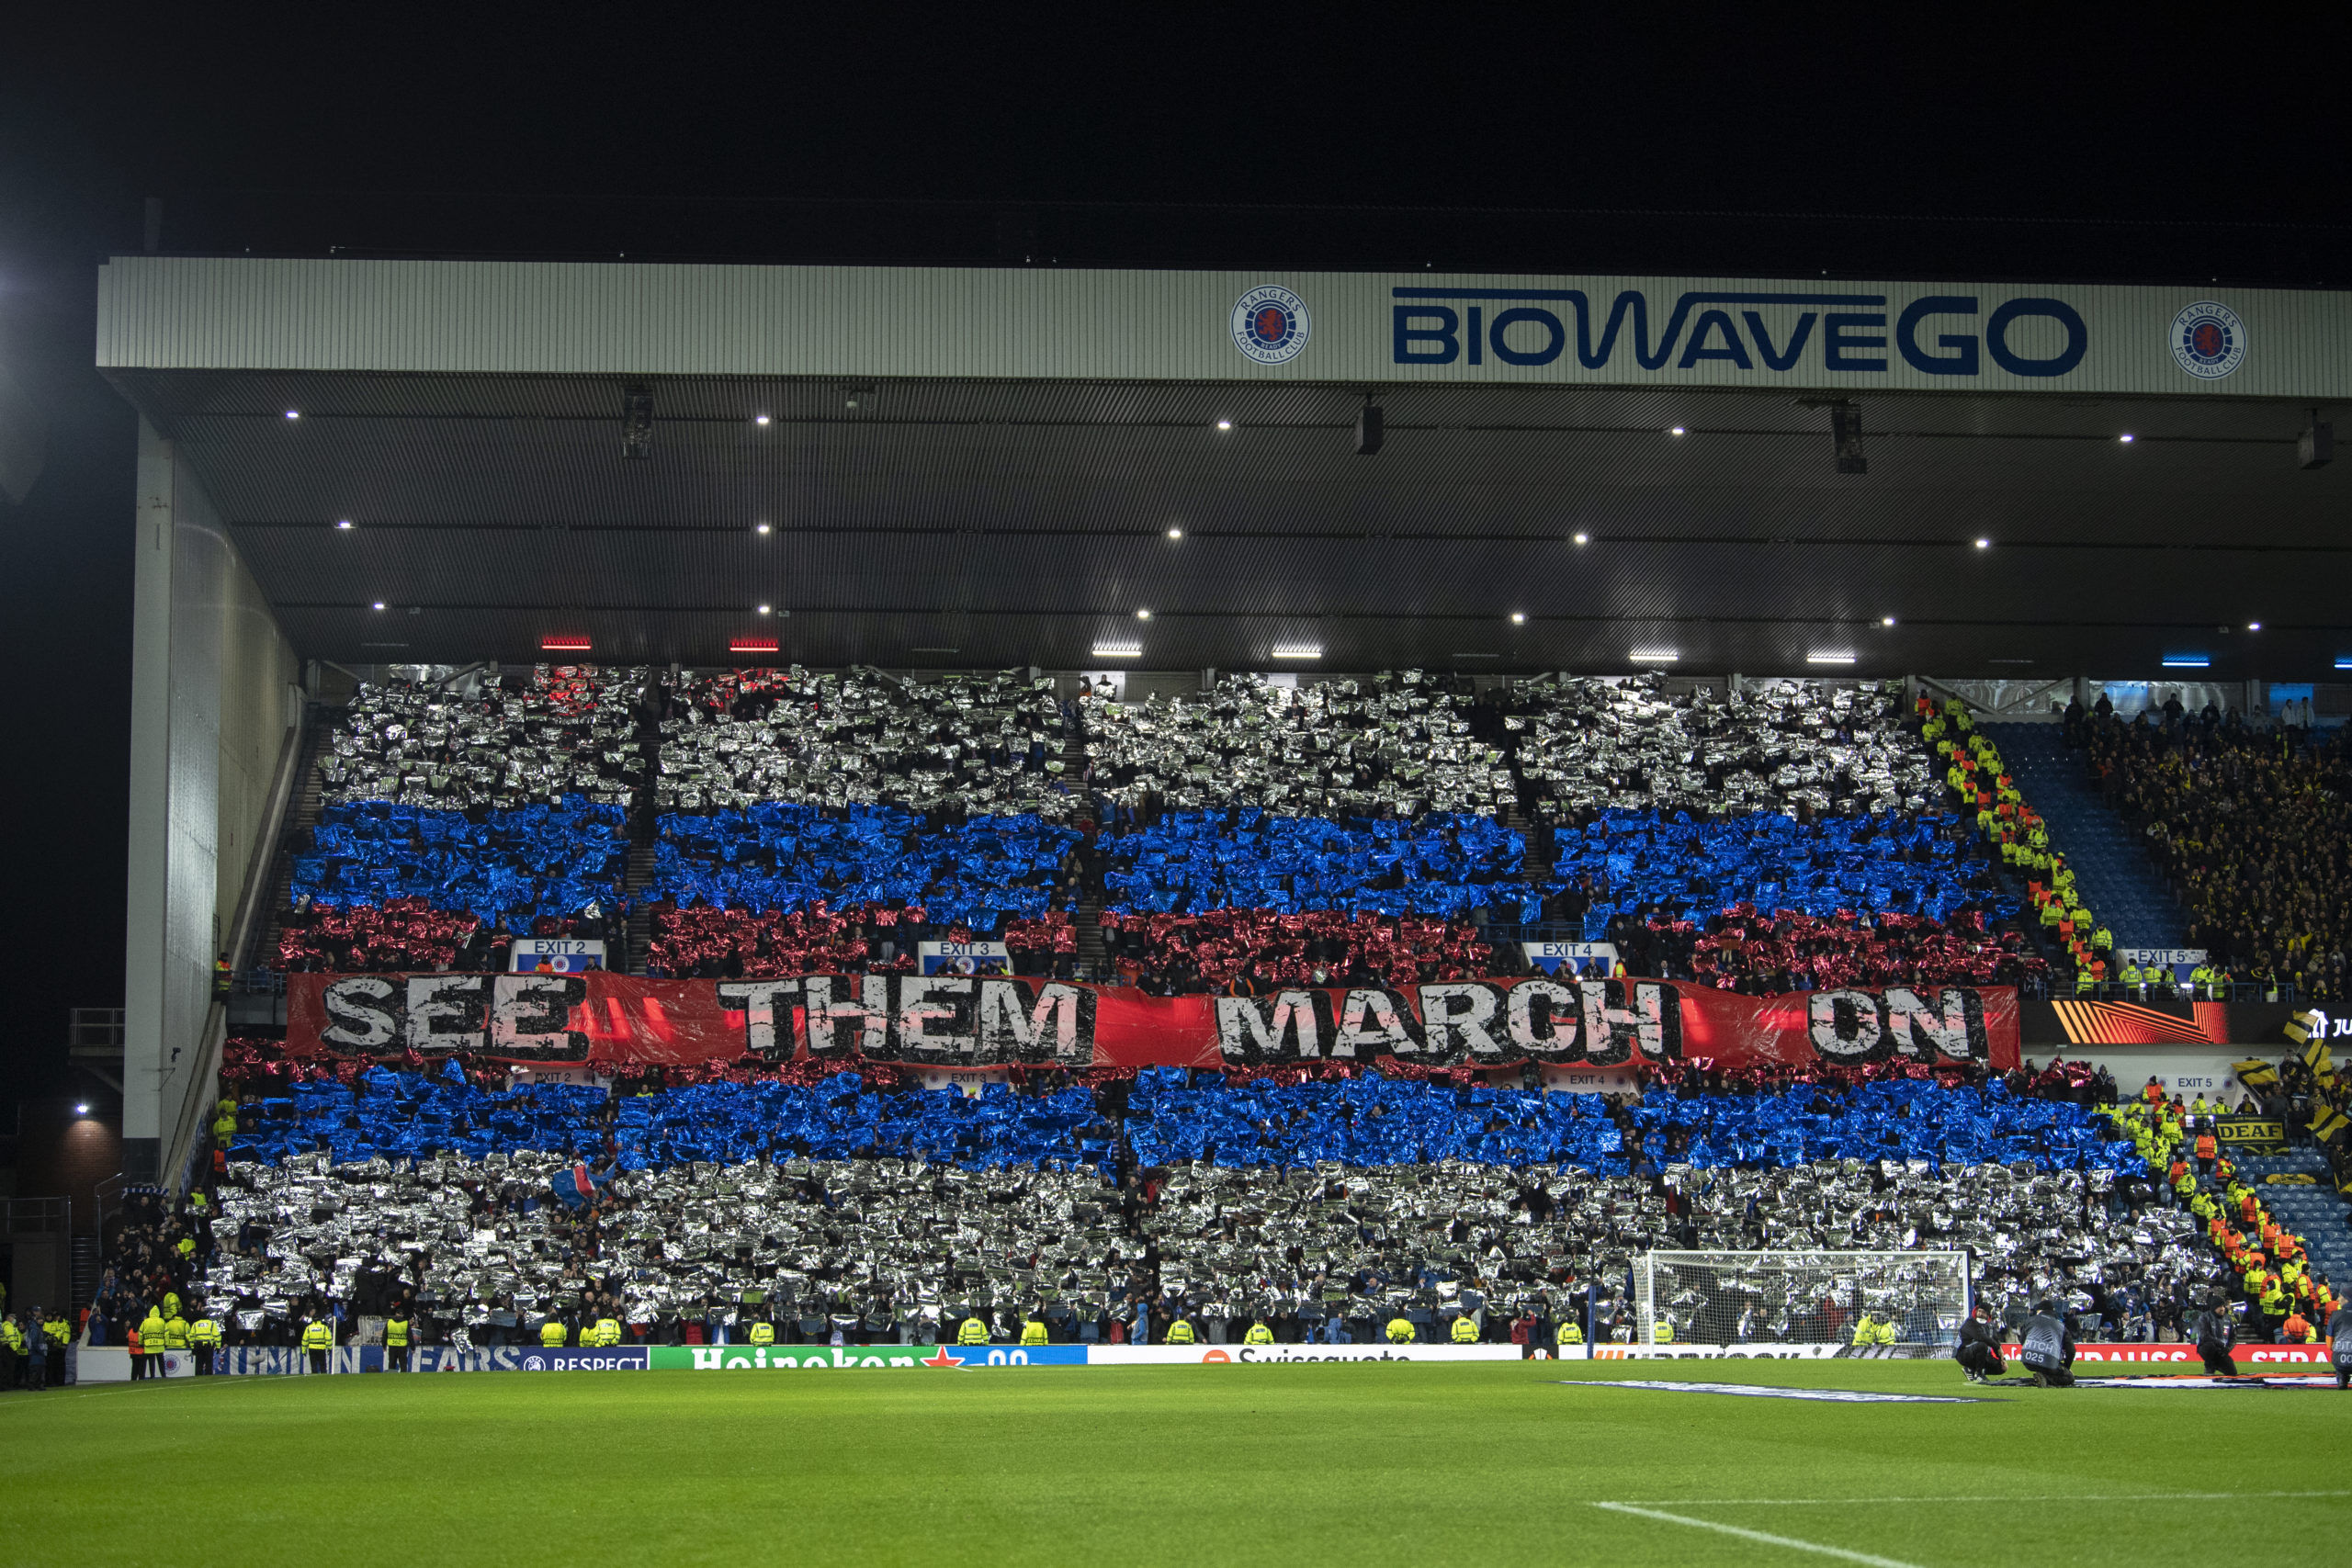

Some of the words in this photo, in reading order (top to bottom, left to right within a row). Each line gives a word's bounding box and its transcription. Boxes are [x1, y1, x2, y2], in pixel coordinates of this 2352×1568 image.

[1240, 289, 1301, 311] RANGERS
[2178, 306, 2237, 327] RANGERS
[1393, 287, 2087, 378] BIOWAVEGO
[1237, 332, 1284, 359] FOOTBALL
[1285, 332, 1305, 355] CLUB
[2176, 346, 2222, 375] FOOTBALL
[2223, 347, 2241, 369] CLUB
[535, 941, 571, 953] EXIT
[576, 941, 585, 953] 2
[940, 942, 976, 955] EXIT
[979, 942, 989, 955] 3
[1544, 943, 1578, 955] EXIT
[1583, 944, 1592, 956] 4
[2138, 950, 2172, 963] EXIT
[2177, 951, 2186, 963] 5
[325, 976, 569, 1049] SEE
[719, 975, 1079, 1056] THEM
[1219, 979, 1663, 1057] MARCH
[1811, 988, 1970, 1057] ON
[564, 1073, 571, 1081] 2
[952, 1073, 977, 1082] EXIT
[979, 1073, 987, 1082] 3
[1570, 1075, 1595, 1084] EXIT
[1599, 1076, 1605, 1084] 4
[2178, 1078, 2203, 1087] EXIT
[2206, 1078, 2212, 1087] 5
[2219, 1124, 2280, 1138] DEAF
[2023, 1339, 2053, 1353] PITCH
[2025, 1352, 2044, 1363] 025
[554, 1358, 643, 1371] RESPECT
